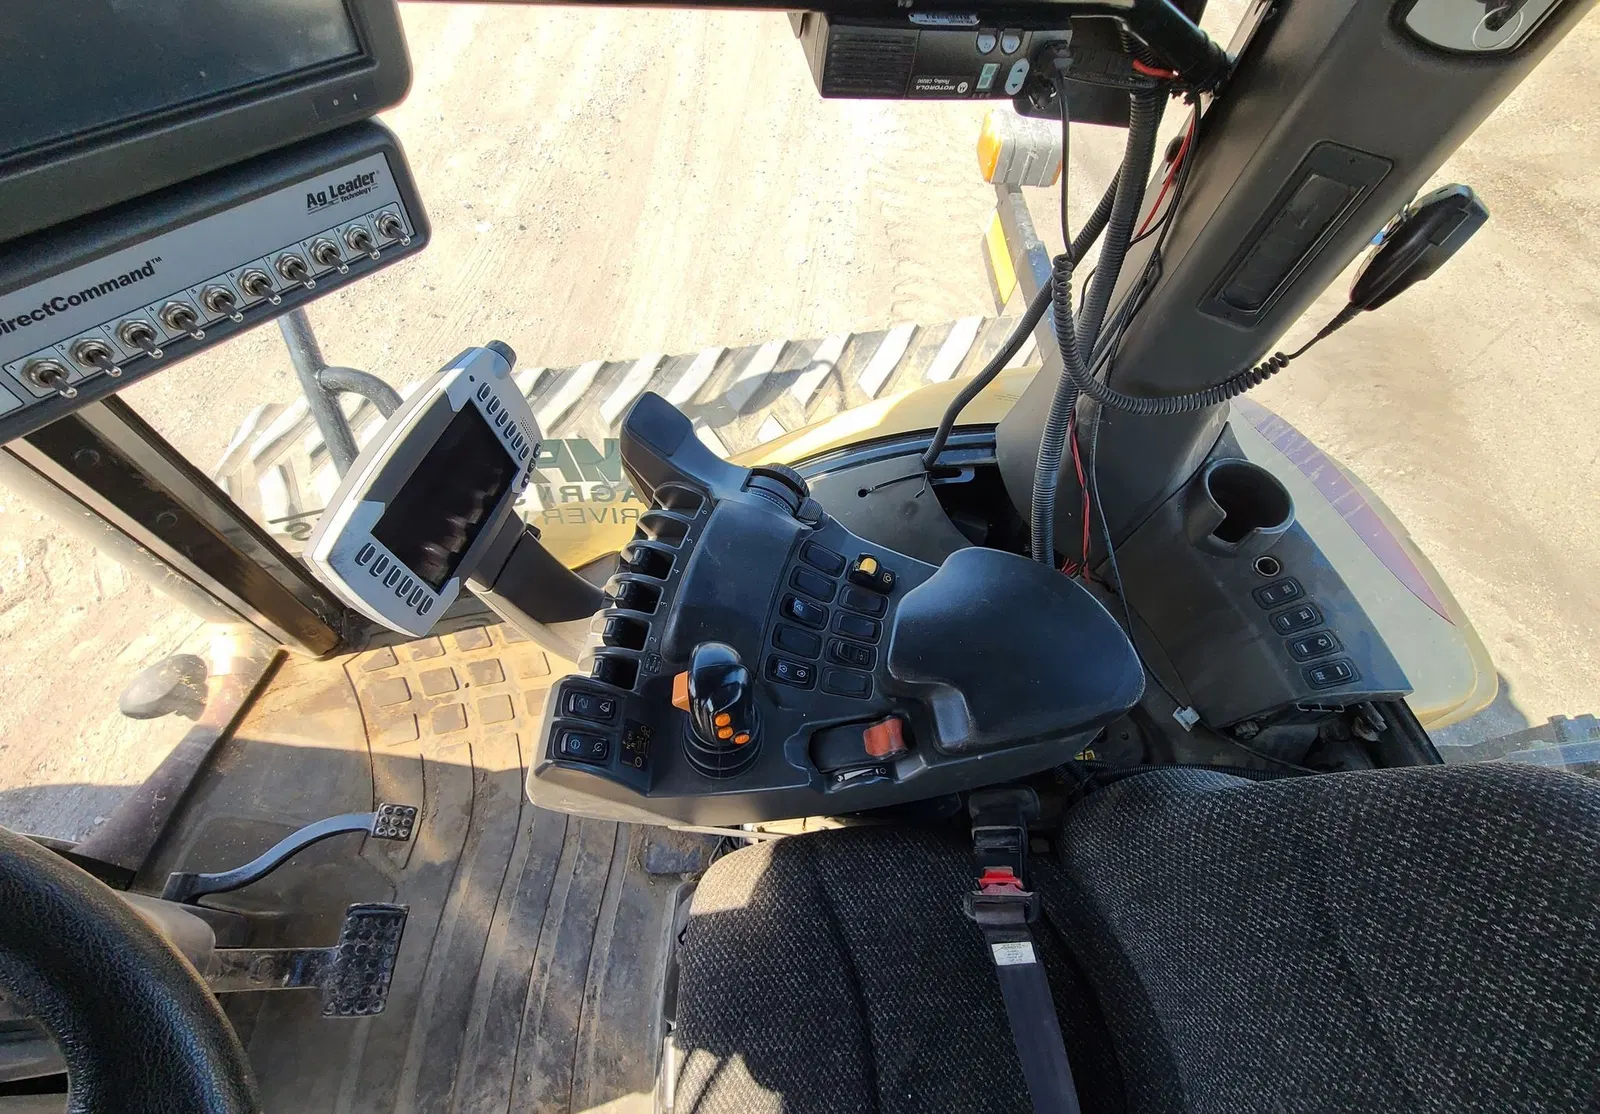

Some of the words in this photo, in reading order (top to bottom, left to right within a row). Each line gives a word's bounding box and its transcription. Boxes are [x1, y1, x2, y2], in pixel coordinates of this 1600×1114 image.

[306, 189, 328, 209] Ag
[328, 171, 377, 199] Leader
[340, 187, 372, 203] Technology
